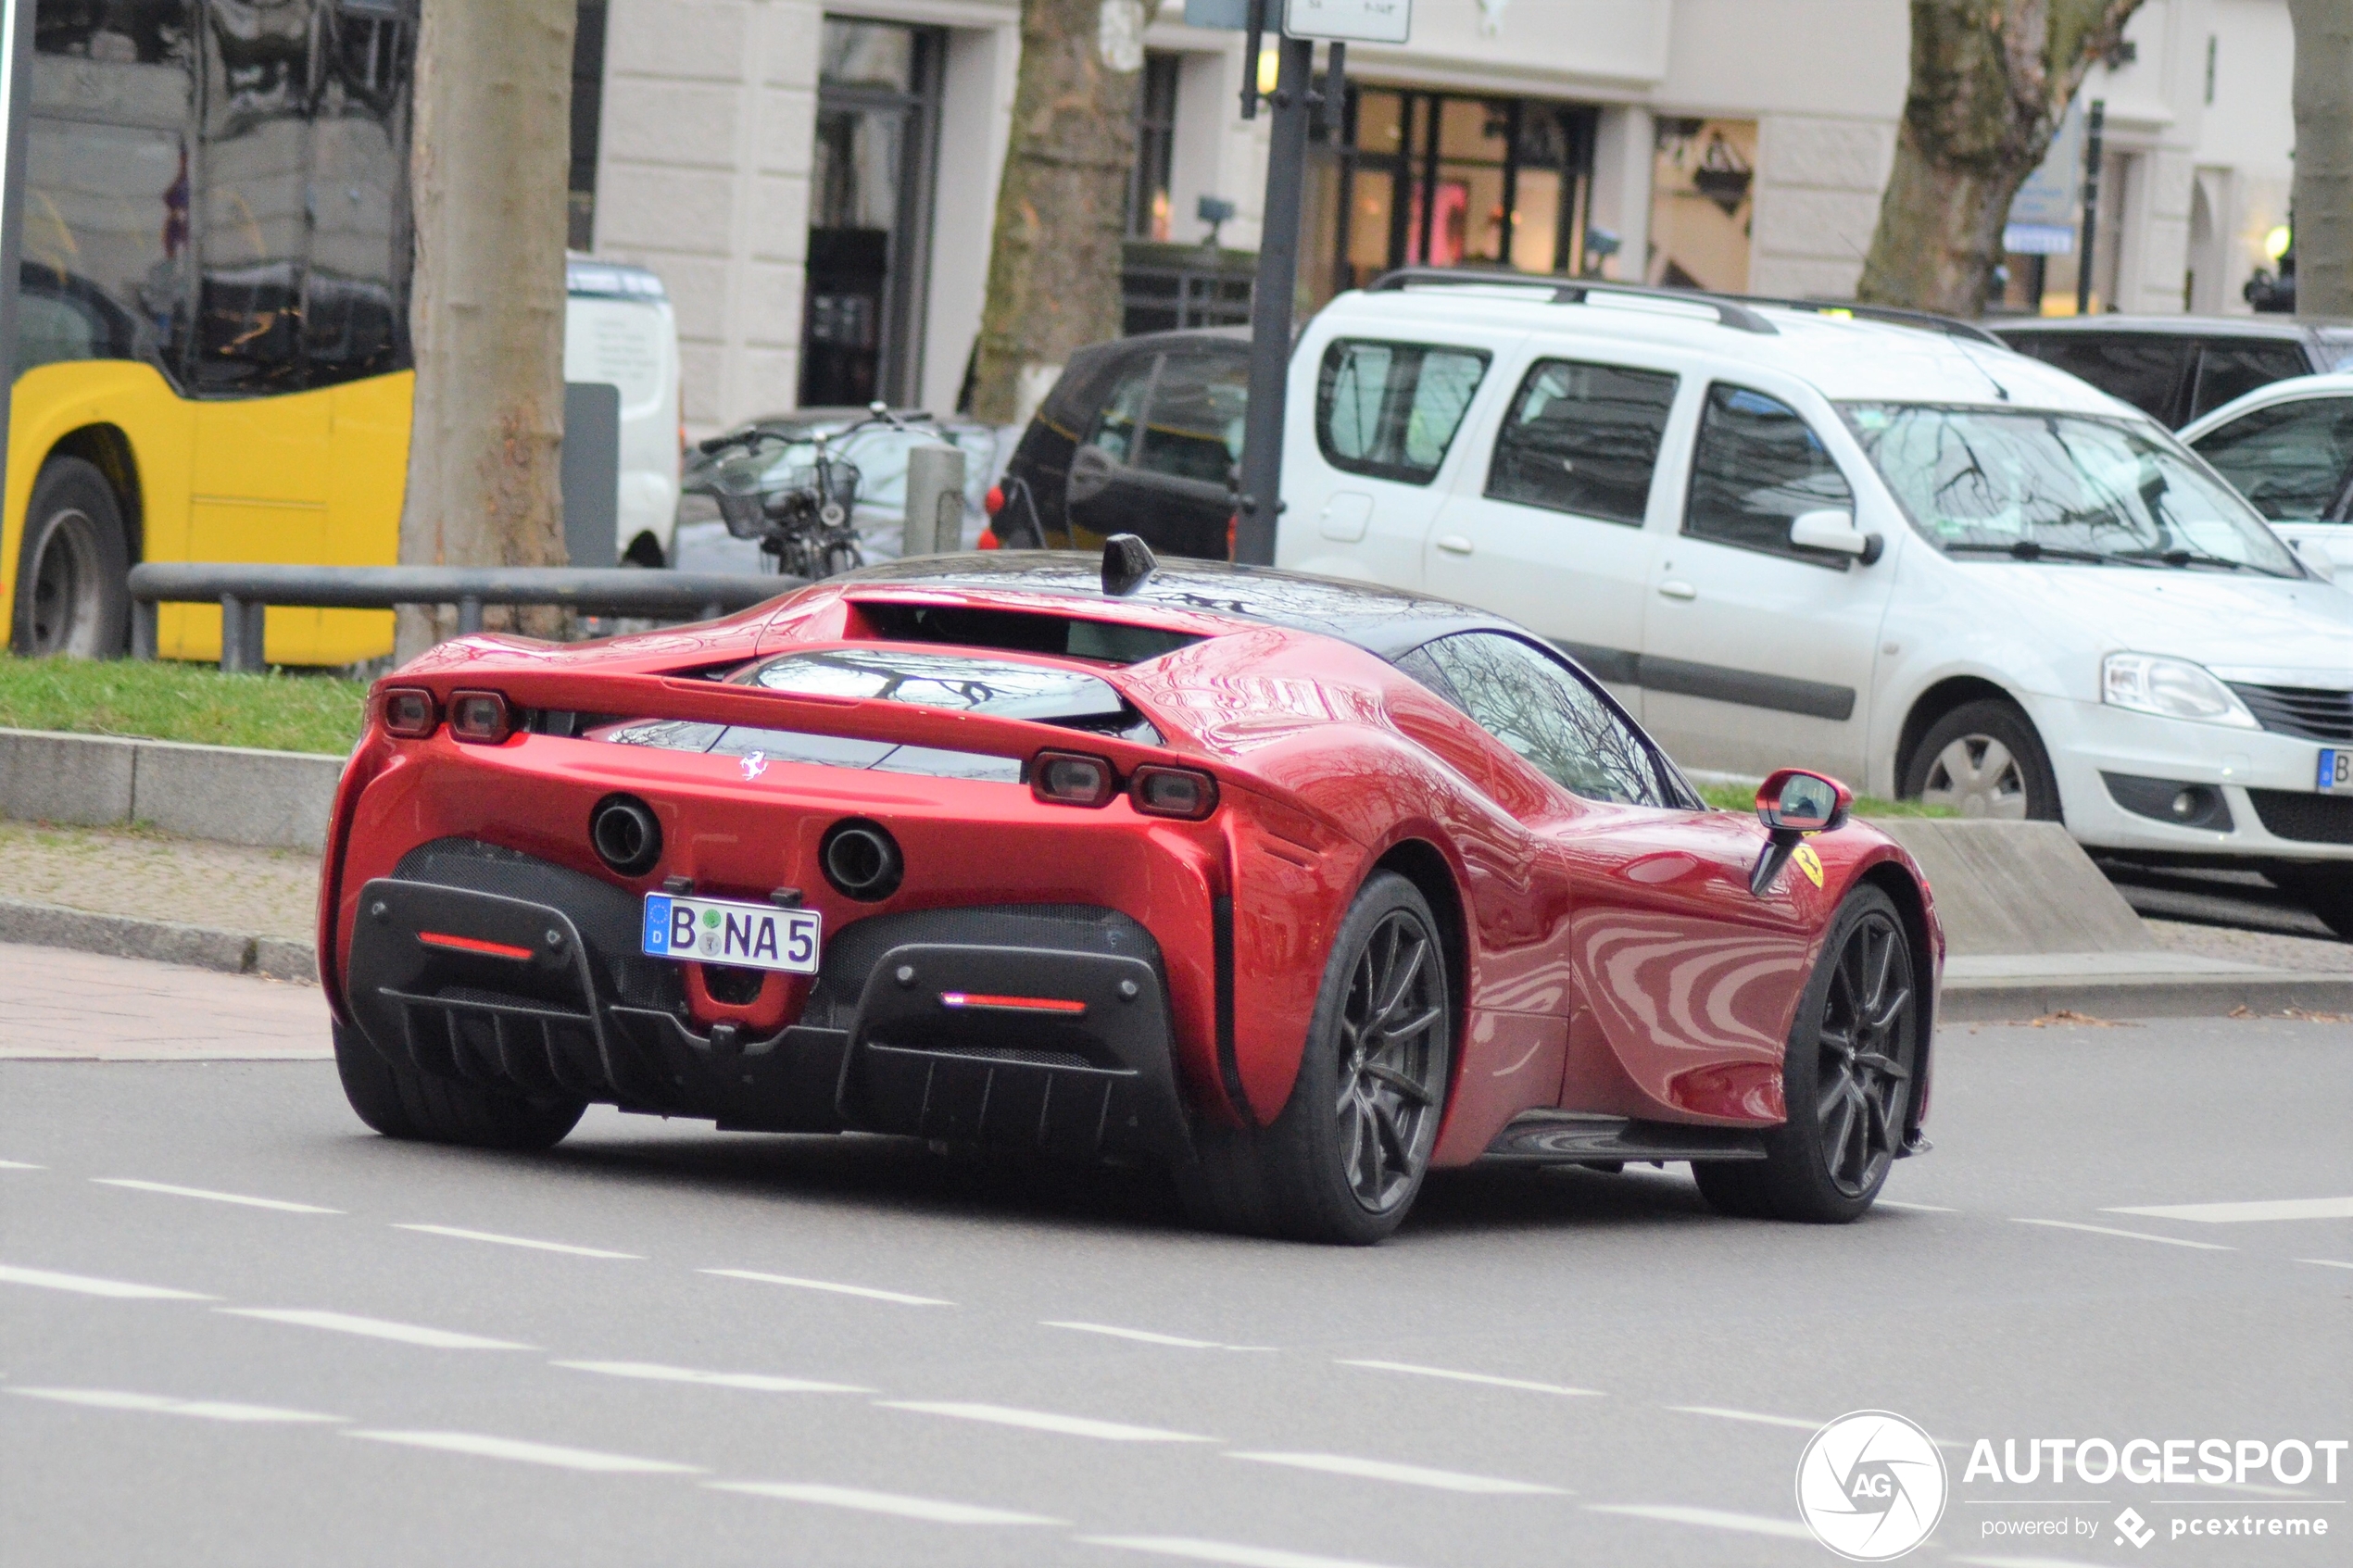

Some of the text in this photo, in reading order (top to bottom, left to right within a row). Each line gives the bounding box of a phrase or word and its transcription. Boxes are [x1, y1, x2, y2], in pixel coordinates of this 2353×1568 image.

[2335, 755, 2349, 783] B
[651, 930, 662, 944] D
[671, 906, 696, 949] B
